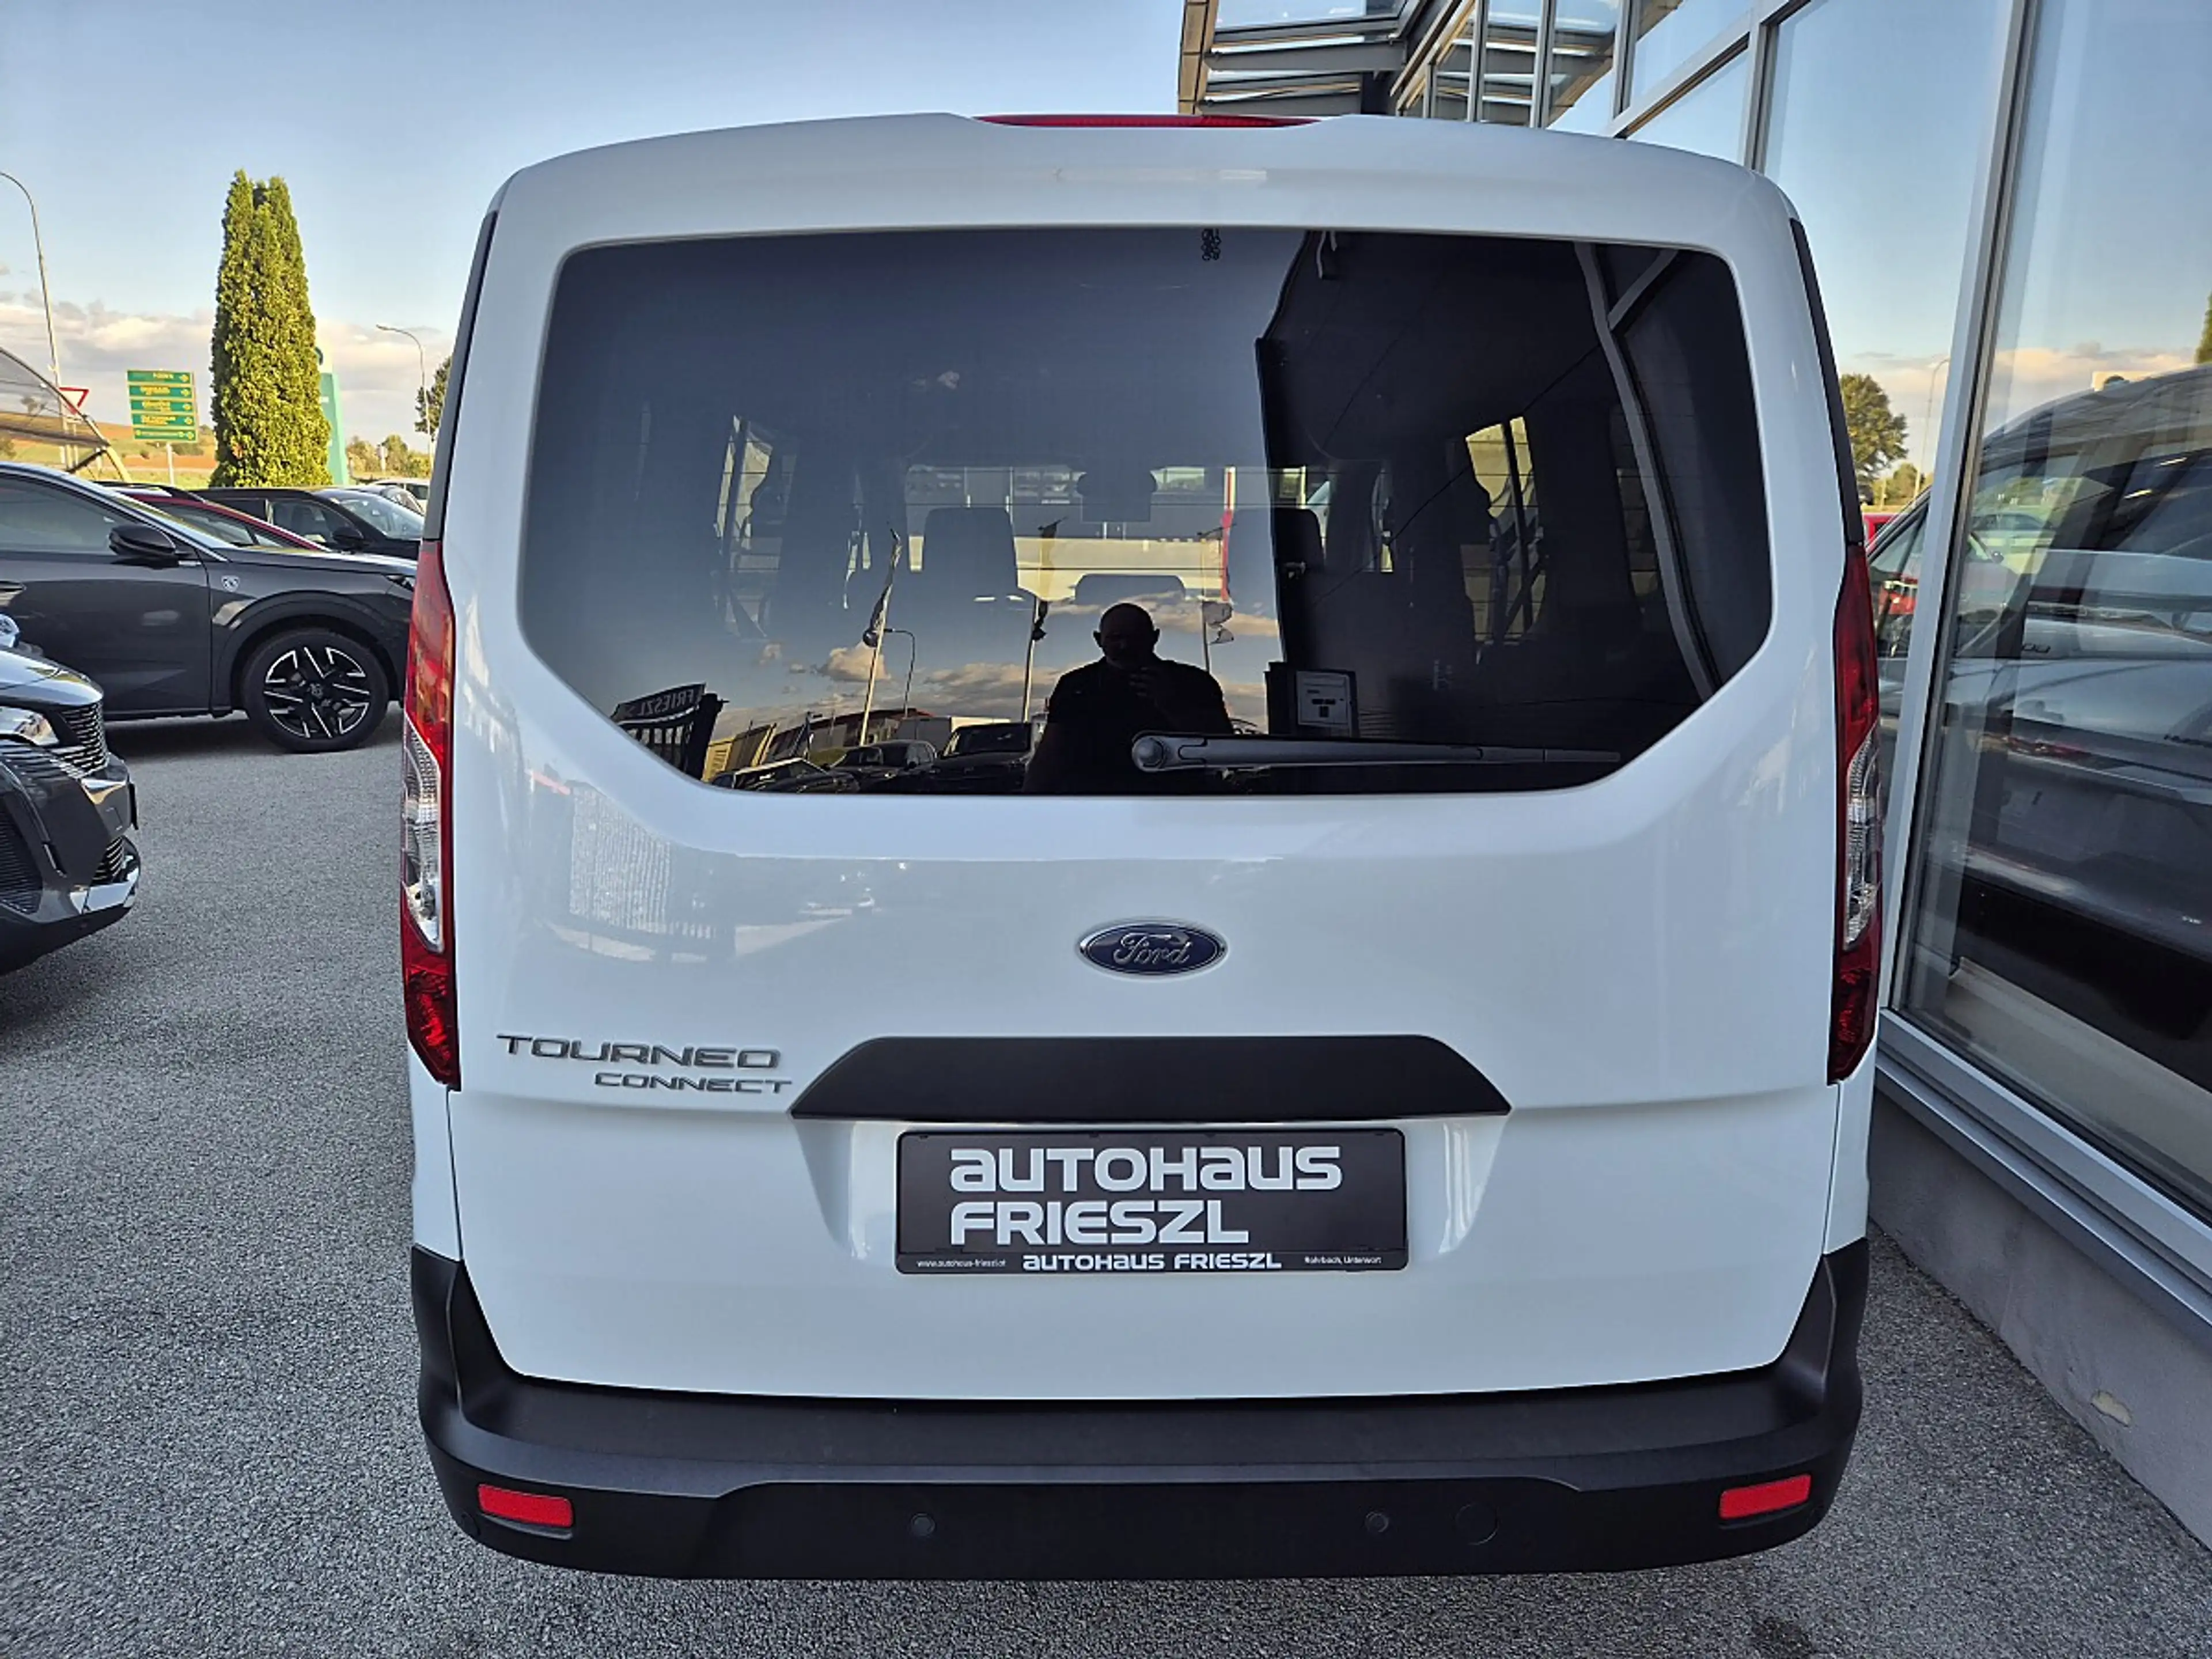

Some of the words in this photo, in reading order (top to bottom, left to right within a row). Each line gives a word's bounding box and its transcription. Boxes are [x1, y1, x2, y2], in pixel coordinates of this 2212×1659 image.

[1113, 931, 1192, 965] Ford
[497, 1034, 781, 1069] TOURNEO
[595, 1072, 792, 1094] CONNECT
[950, 1146, 1343, 1192] AUTOHAUS
[950, 1200, 1249, 1245] FRIESZL
[1022, 1253, 1165, 1271] AUTOHAUS
[1173, 1252, 1282, 1270] FRIESZL
